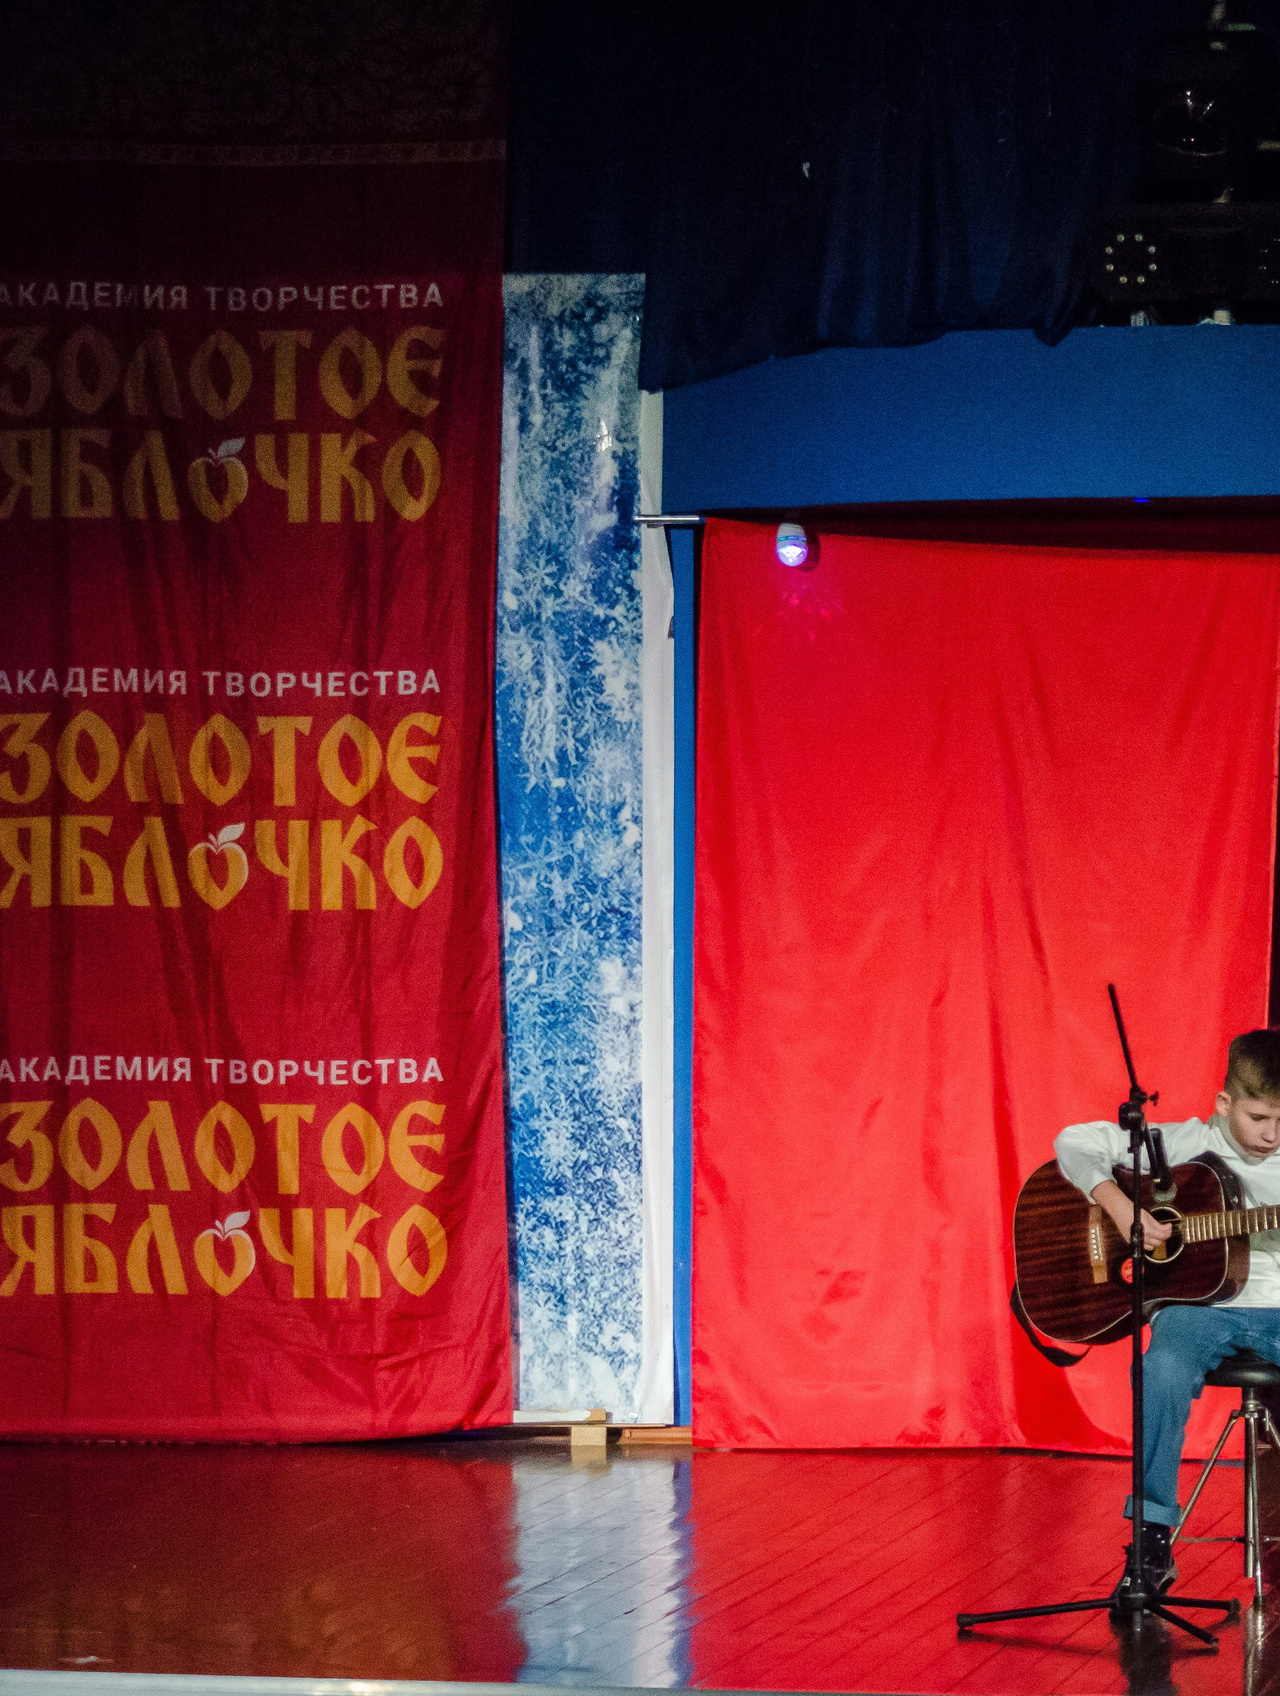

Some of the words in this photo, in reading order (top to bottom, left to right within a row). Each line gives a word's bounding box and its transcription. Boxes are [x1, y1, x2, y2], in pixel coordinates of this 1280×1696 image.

[206, 283, 443, 312] ТВОРЧЕСТВА
[0, 428, 442, 524] ЯБЛОЧКО
[202, 670, 441, 697] ТВОРЧЕСТВА
[0, 815, 444, 911] ЯБЛОЧКО
[0, 1055, 192, 1085] АКАДЕМИЯ
[204, 1058, 444, 1085] ТВОРЧЕСТВА
[0, 1203, 448, 1299] ЯБЛОЧКО
